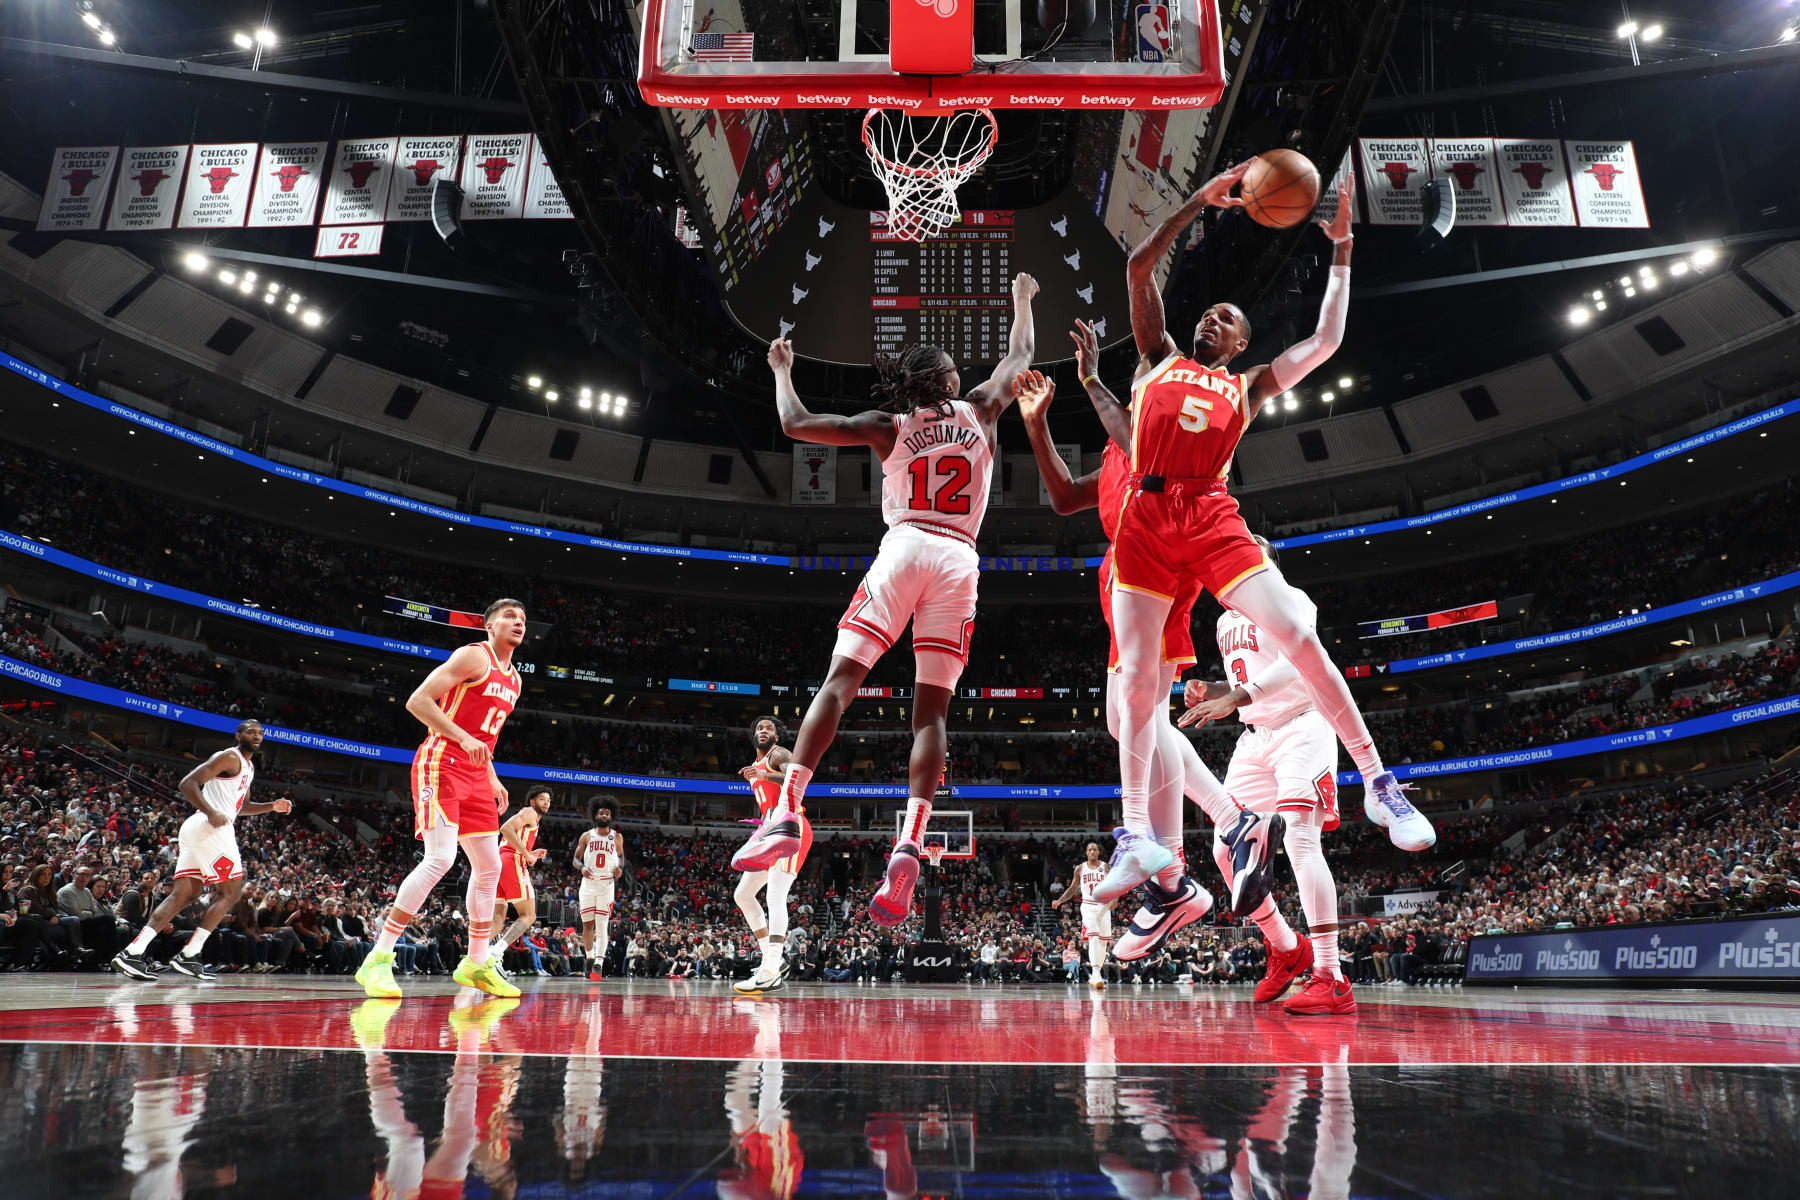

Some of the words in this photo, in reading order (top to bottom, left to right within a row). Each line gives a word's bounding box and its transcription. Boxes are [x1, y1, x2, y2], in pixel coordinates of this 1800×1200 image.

[1142, 50, 1159, 62] NBA
[656, 93, 710, 106] betway
[726, 94, 781, 106] betway
[797, 94, 851, 106] betway
[868, 94, 922, 108] betway
[938, 94, 994, 107] betway
[1010, 94, 1064, 106] betway
[1081, 94, 1135, 106] betway
[1152, 94, 1206, 107] betway
[344, 143, 389, 153] CHICAGO
[406, 142, 453, 150] CHICAGO
[475, 139, 522, 148] CHICAGO
[1370, 144, 1418, 152] CHICAGO
[1436, 144, 1486, 152] CHICAGO
[1504, 144, 1553, 153] CHICAGO
[1575, 145, 1624, 154] CHICAGO
[62, 152, 109, 160] CHICAGO
[132, 151, 179, 160] CHICAGO
[200, 149, 248, 158] CHICAGO
[271, 147, 318, 156] CHICAGO
[349, 153, 381, 161] BULLS
[412, 150, 445, 159] BULLS
[482, 148, 516, 157] BULLS
[1378, 152, 1414, 161] BULLS
[1446, 152, 1481, 161] BULLS
[1513, 153, 1548, 161] BULLS
[68, 160, 101, 168] BULLS
[137, 160, 171, 169] BULLS
[206, 158, 240, 166] BULLS
[276, 156, 310, 165] BULLS
[1583, 154, 1619, 163] BULLS
[344, 188, 371, 196] CENTRAL
[342, 196, 371, 204] DIVISION
[470, 200, 511, 208] CHAMPIONS
[192, 209, 233, 217] CHAMPIONS
[336, 204, 374, 212] CHAMPIONS
[972, 212, 984, 224] 10
[338, 232, 360, 250] 72
[10, 360, 38, 378] UNITED
[1178, 394, 1214, 434] 5
[110, 405, 139, 421] OFFICIAL
[140, 416, 164, 431] AIRLINE
[174, 428, 186, 439] THE
[186, 433, 216, 449] CHICAGO
[903, 424, 981, 455] DOSUNMU
[1654, 446, 1681, 460] OFFICIAL
[1716, 427, 1729, 438] THE
[1729, 416, 1762, 433] CHICAGO
[276, 466, 301, 478] UNITED
[908, 455, 972, 515] 12
[1561, 476, 1587, 487] UNITED
[365, 490, 389, 501] OFFICIAL
[429, 508, 454, 519] CHICAGO
[1408, 516, 1431, 526] OFFICIAL
[1472, 499, 1499, 511] CHICAGO
[22, 541, 45, 556] BULLS
[590, 539, 612, 548] OFFICIAL
[800, 556, 877, 571] UNIT
[978, 556, 1074, 571] ENTER
[97, 569, 127, 583] UNITED
[1701, 594, 1734, 607] UNITED
[208, 600, 237, 613] OFFICIAL
[237, 608, 261, 621] AIRLINE
[262, 614, 271, 623] OF
[272, 617, 283, 626] THE
[284, 620, 314, 633] CHICAGO
[314, 628, 335, 637] BULLS
[1516, 638, 1545, 650] OFFICIAL
[1545, 634, 1571, 645] AIRLINE
[1572, 631, 1581, 639] OF
[1582, 627, 1594, 637] THE
[1594, 620, 1627, 634] CHICAGO
[384, 641, 410, 651] UNITED
[1418, 656, 1444, 666] UNITED
[517, 662, 535, 674] 7:20
[1232, 658, 1249, 689] 3
[5, 662, 40, 681] CHICAGO
[40, 673, 62, 688] BULLS
[482, 682, 518, 708] ATLANT
[858, 688, 883, 697] ATLANTA
[900, 688, 904, 697] 7
[968, 689, 976, 697] 10
[990, 689, 1017, 697] CHICAGO
[126, 698, 158, 711] UNITED
[1732, 708, 1767, 722] OFFICIAL
[1768, 699, 1800, 714] AIRLINE
[480, 706, 507, 736] 13
[274, 730, 301, 743] AIRLINE
[302, 735, 312, 745] OF
[312, 737, 326, 747] THE
[326, 740, 359, 753] CHICAGO
[360, 746, 381, 757] BULLS
[1611, 734, 1645, 745] UNITED
[1410, 764, 1440, 775] OFFICIAL
[1440, 760, 1469, 771] AIRLINE
[1470, 760, 1480, 768] OF
[1481, 757, 1494, 767] THE
[1495, 752, 1531, 765] CHICAGO
[1532, 748, 1553, 760] BULLS
[544, 770, 574, 780] OFFICIAL
[574, 774, 600, 783] AIRLINE
[610, 777, 622, 785] THE
[623, 778, 655, 787] CHICAGO
[656, 780, 676, 788] BULLS
[589, 840, 615, 855] BULLS
[596, 854, 606, 869] 0
[1083, 872, 1105, 884] BULLS
[913, 956, 952, 967] KIA
[1536, 950, 1600, 971] Plus500
[1615, 946, 1697, 970] Plus500
[1719, 942, 1800, 969] Plus50
[1472, 952, 1523, 972] Plus500
